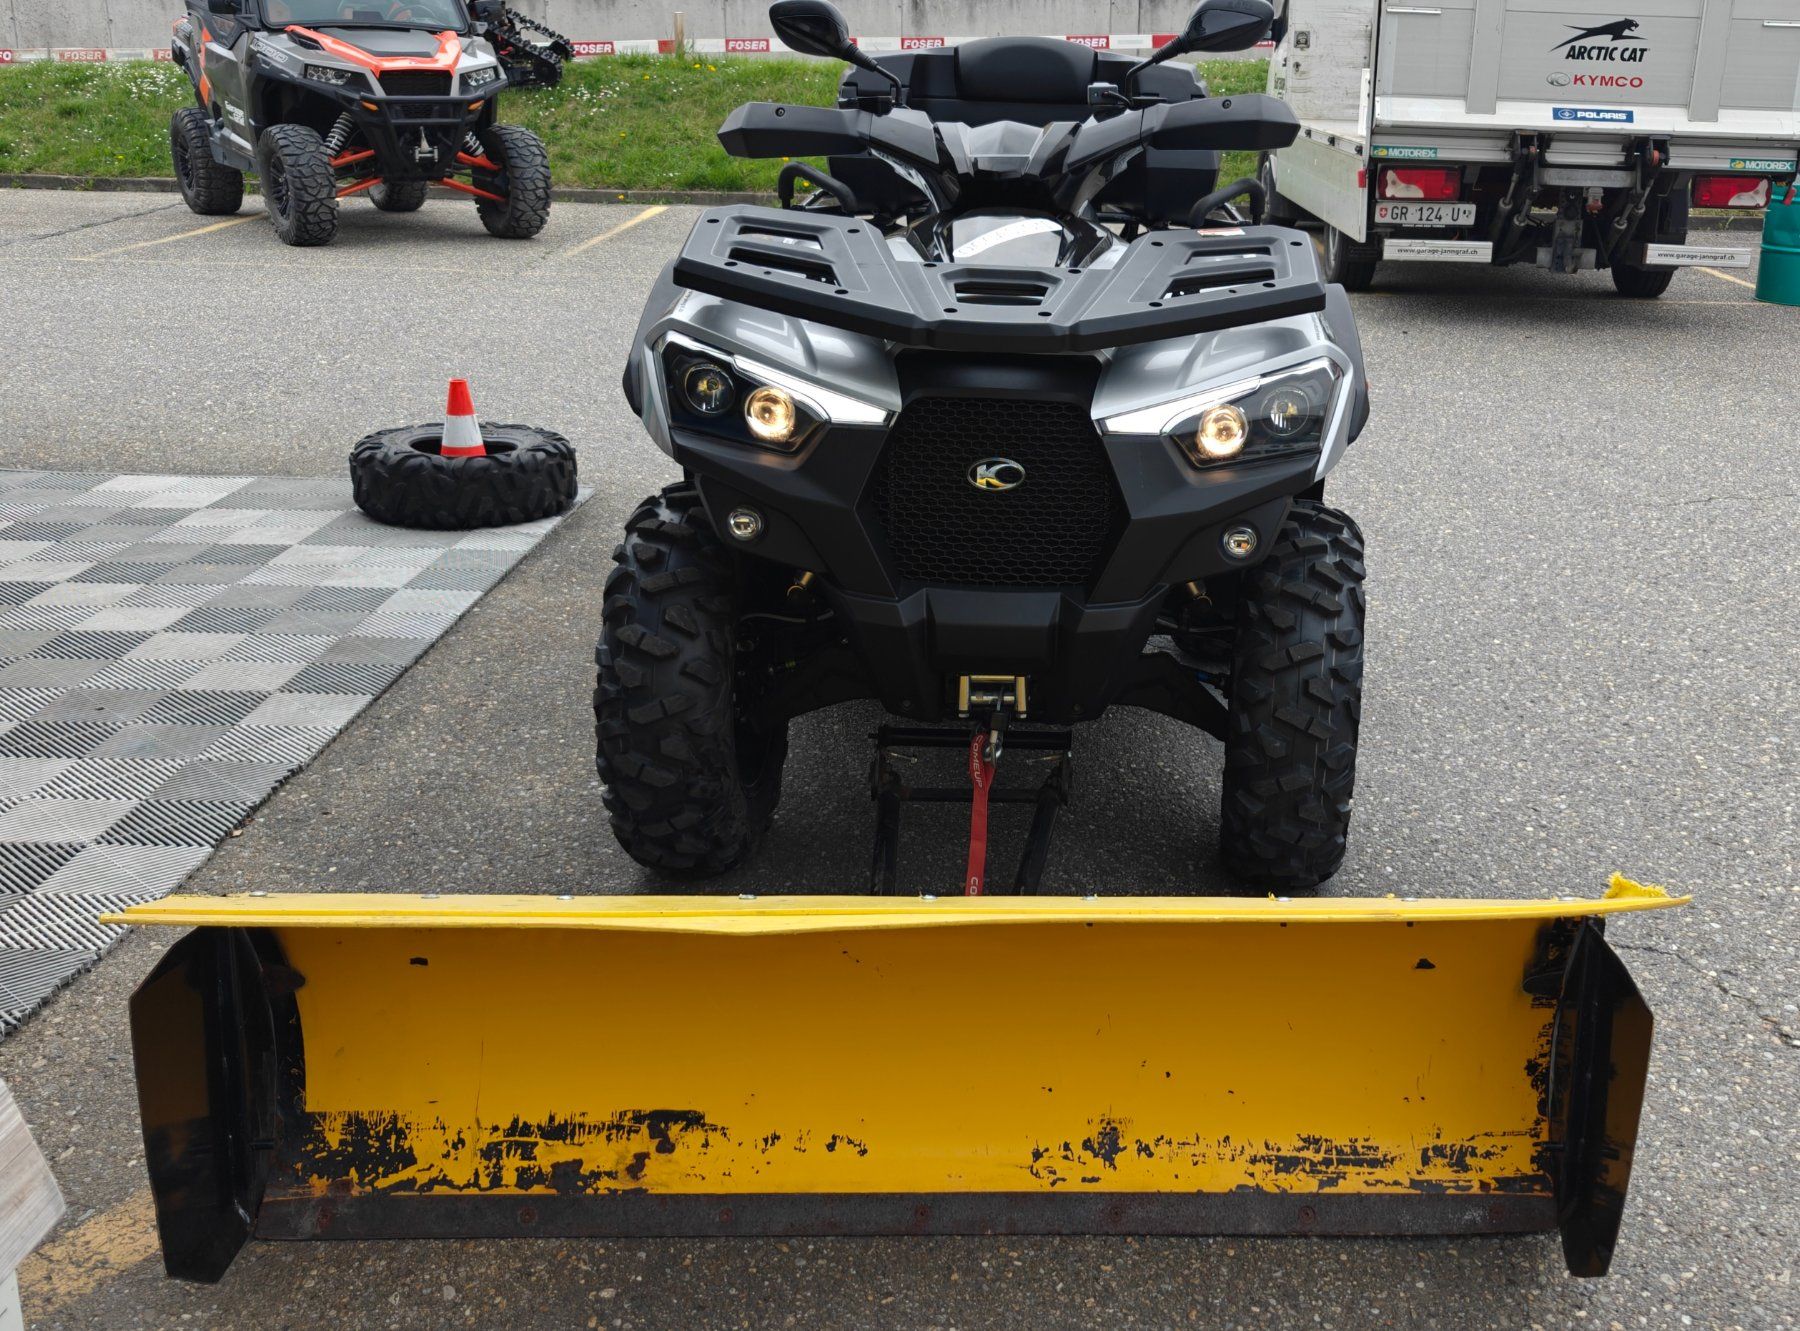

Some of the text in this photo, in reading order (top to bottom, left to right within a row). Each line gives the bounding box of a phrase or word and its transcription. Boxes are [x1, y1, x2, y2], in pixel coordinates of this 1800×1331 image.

[573, 43, 612, 54] FOSER
[728, 40, 767, 50] FOSER
[903, 38, 942, 49] FOSER
[64, 51, 101, 60] FOSER
[1565, 44, 1648, 62] ARCTIC CAT
[1573, 74, 1643, 88] KYMCO
[1577, 111, 1628, 120] POLARIS
[1388, 147, 1436, 157] MOTOREX
[1745, 160, 1791, 170] MOTOREX
[1390, 206, 1460, 222] GR 124 U
[972, 735, 984, 788] COMEUP
